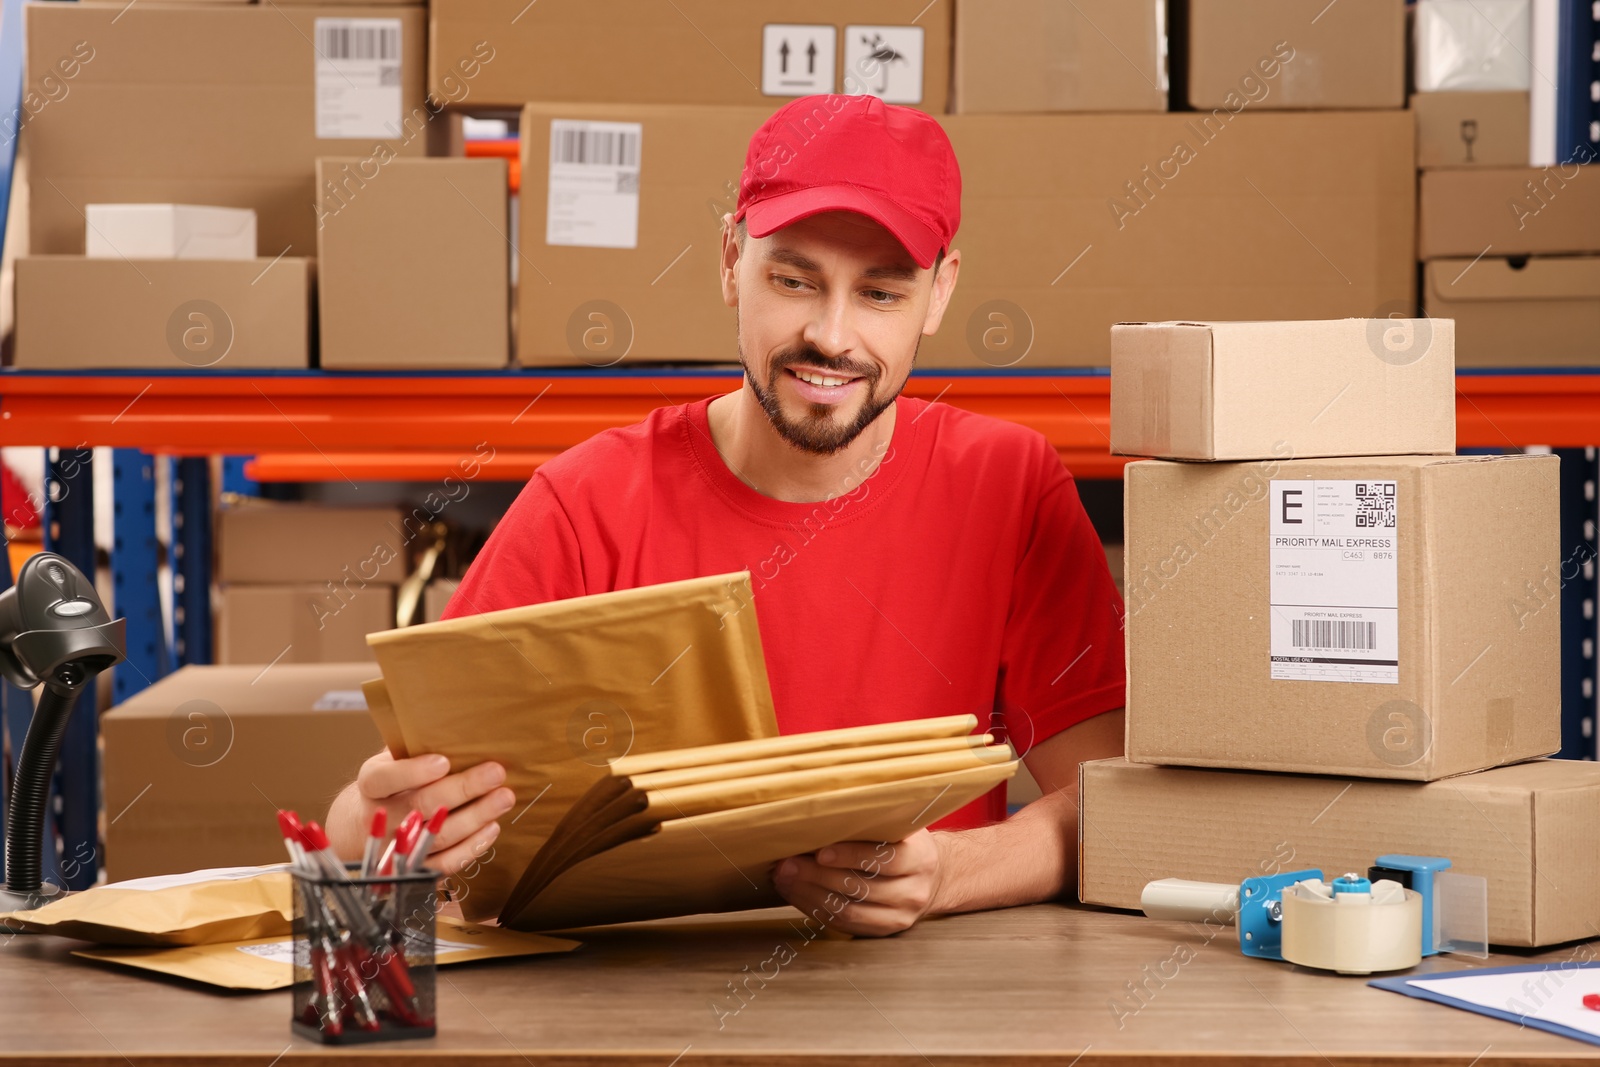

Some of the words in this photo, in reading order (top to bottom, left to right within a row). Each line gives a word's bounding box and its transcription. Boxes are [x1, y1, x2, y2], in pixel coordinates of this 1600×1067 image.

[1283, 490, 1302, 524] E
[1275, 538, 1319, 547] PRIORITY
[1322, 538, 1344, 548] MAIL
[1346, 539, 1391, 548] EXPRESS
[1343, 551, 1363, 559] C463
[1373, 552, 1393, 560] 8876
